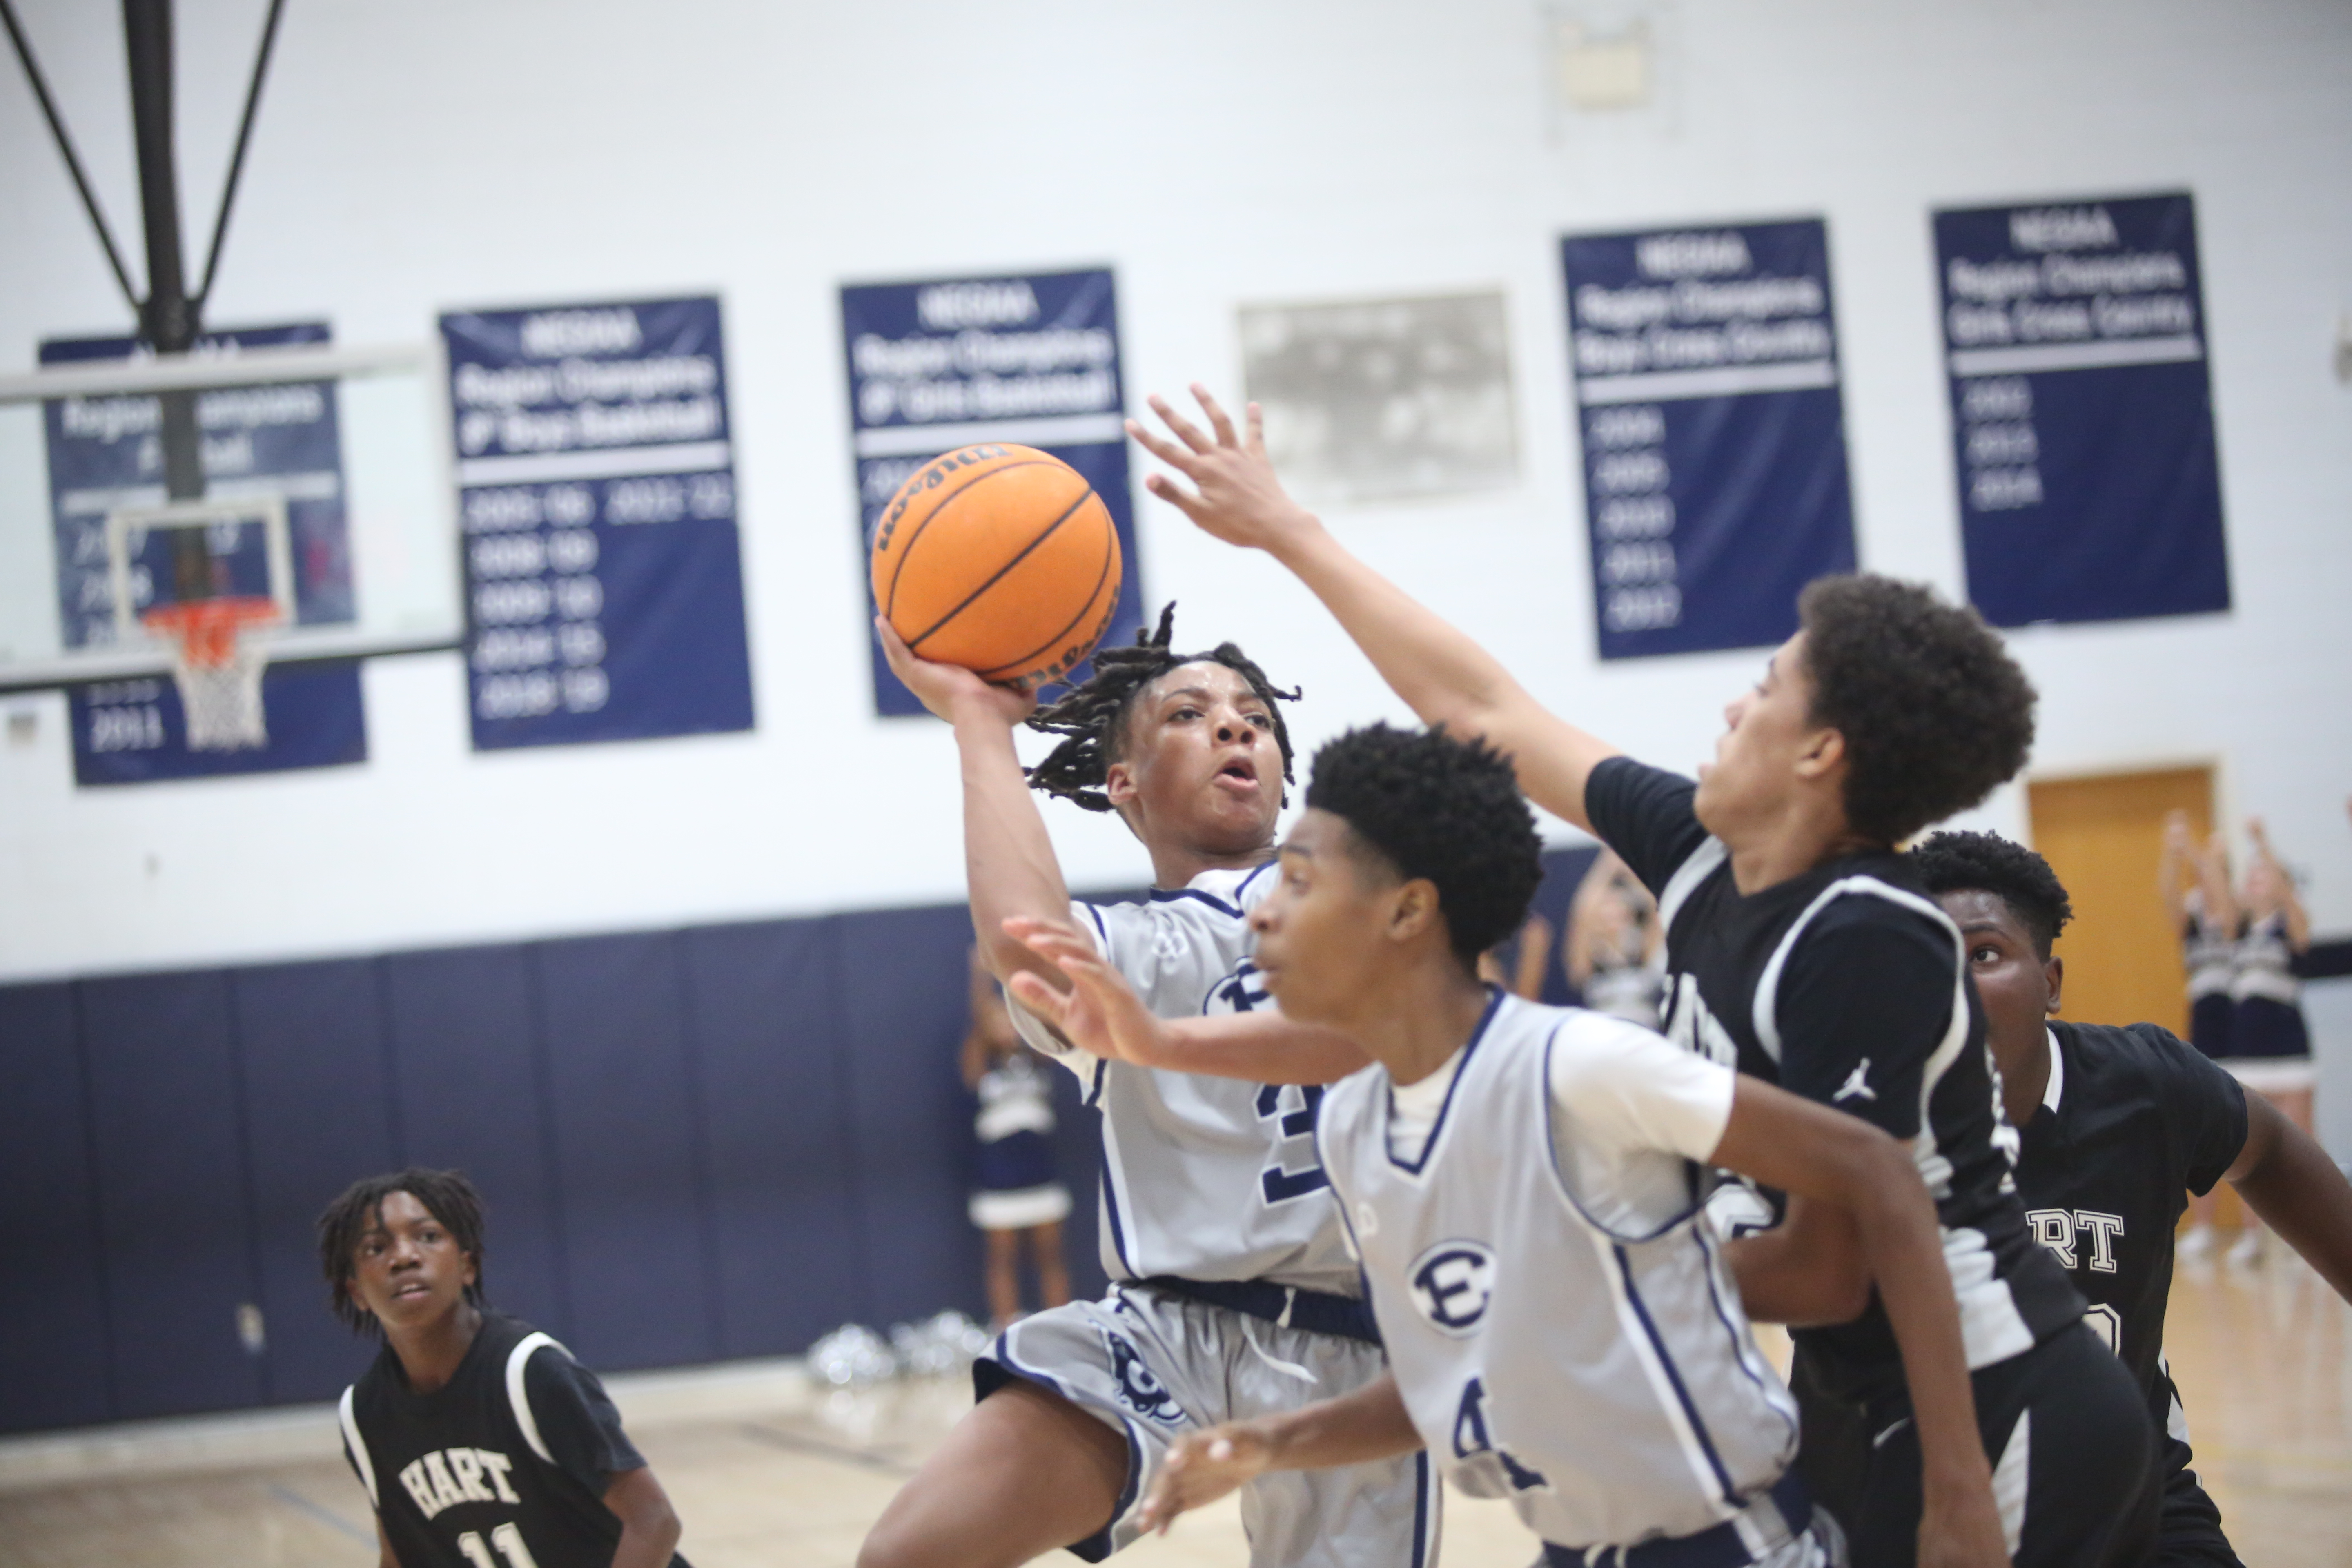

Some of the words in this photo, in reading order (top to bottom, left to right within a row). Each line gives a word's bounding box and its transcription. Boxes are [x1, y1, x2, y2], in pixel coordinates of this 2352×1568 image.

[1949, 256, 2039, 298] Region
[2045, 249, 2185, 293] Champions
[1577, 284, 1669, 327] Region
[1675, 277, 1825, 319] Champions
[2015, 298, 2089, 339] Cross
[2093, 294, 2192, 335] Country
[856, 333, 952, 376] Region
[956, 328, 1111, 371] Champions
[1651, 327, 1723, 367] Cross
[1728, 321, 1831, 363] Country
[458, 364, 553, 408] Region
[558, 357, 715, 401] Champions
[878, 445, 1013, 550] Wilson
[2025, 1208, 2125, 1274] RT
[399, 1447, 521, 1521] HART
